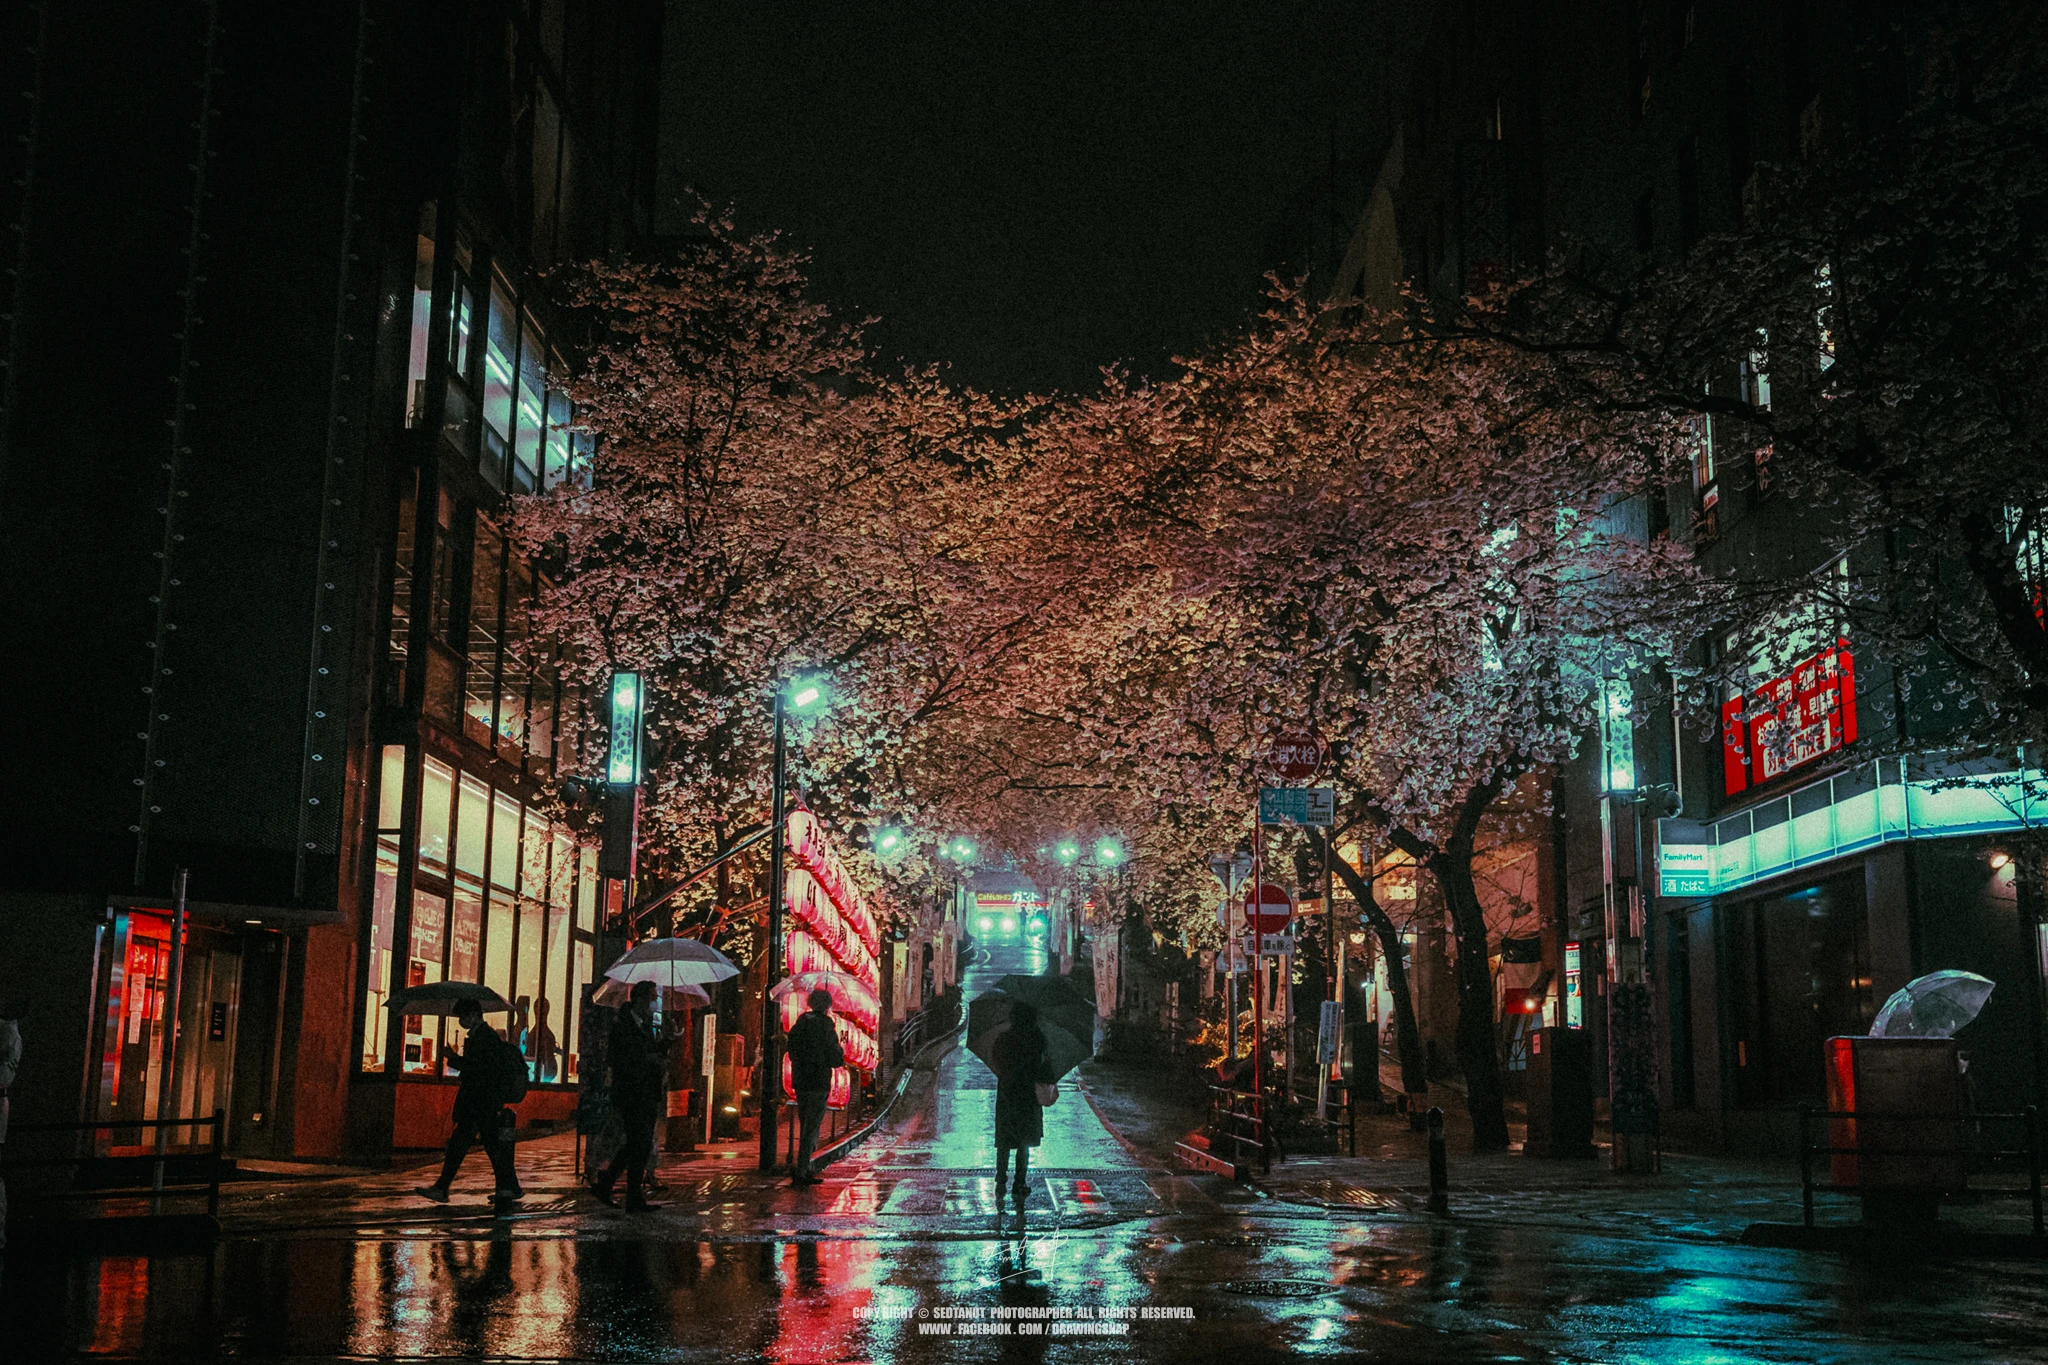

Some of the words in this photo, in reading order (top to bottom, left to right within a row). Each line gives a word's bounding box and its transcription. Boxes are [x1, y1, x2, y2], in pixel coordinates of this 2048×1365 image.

[1274, 745, 1317, 765] 消火栓
[1664, 853, 1703, 861] FamilyMart
[1664, 879, 1677, 893] 酒
[1681, 881, 1706, 892] たばこ
[1247, 939, 1291, 951] 自車を除く
